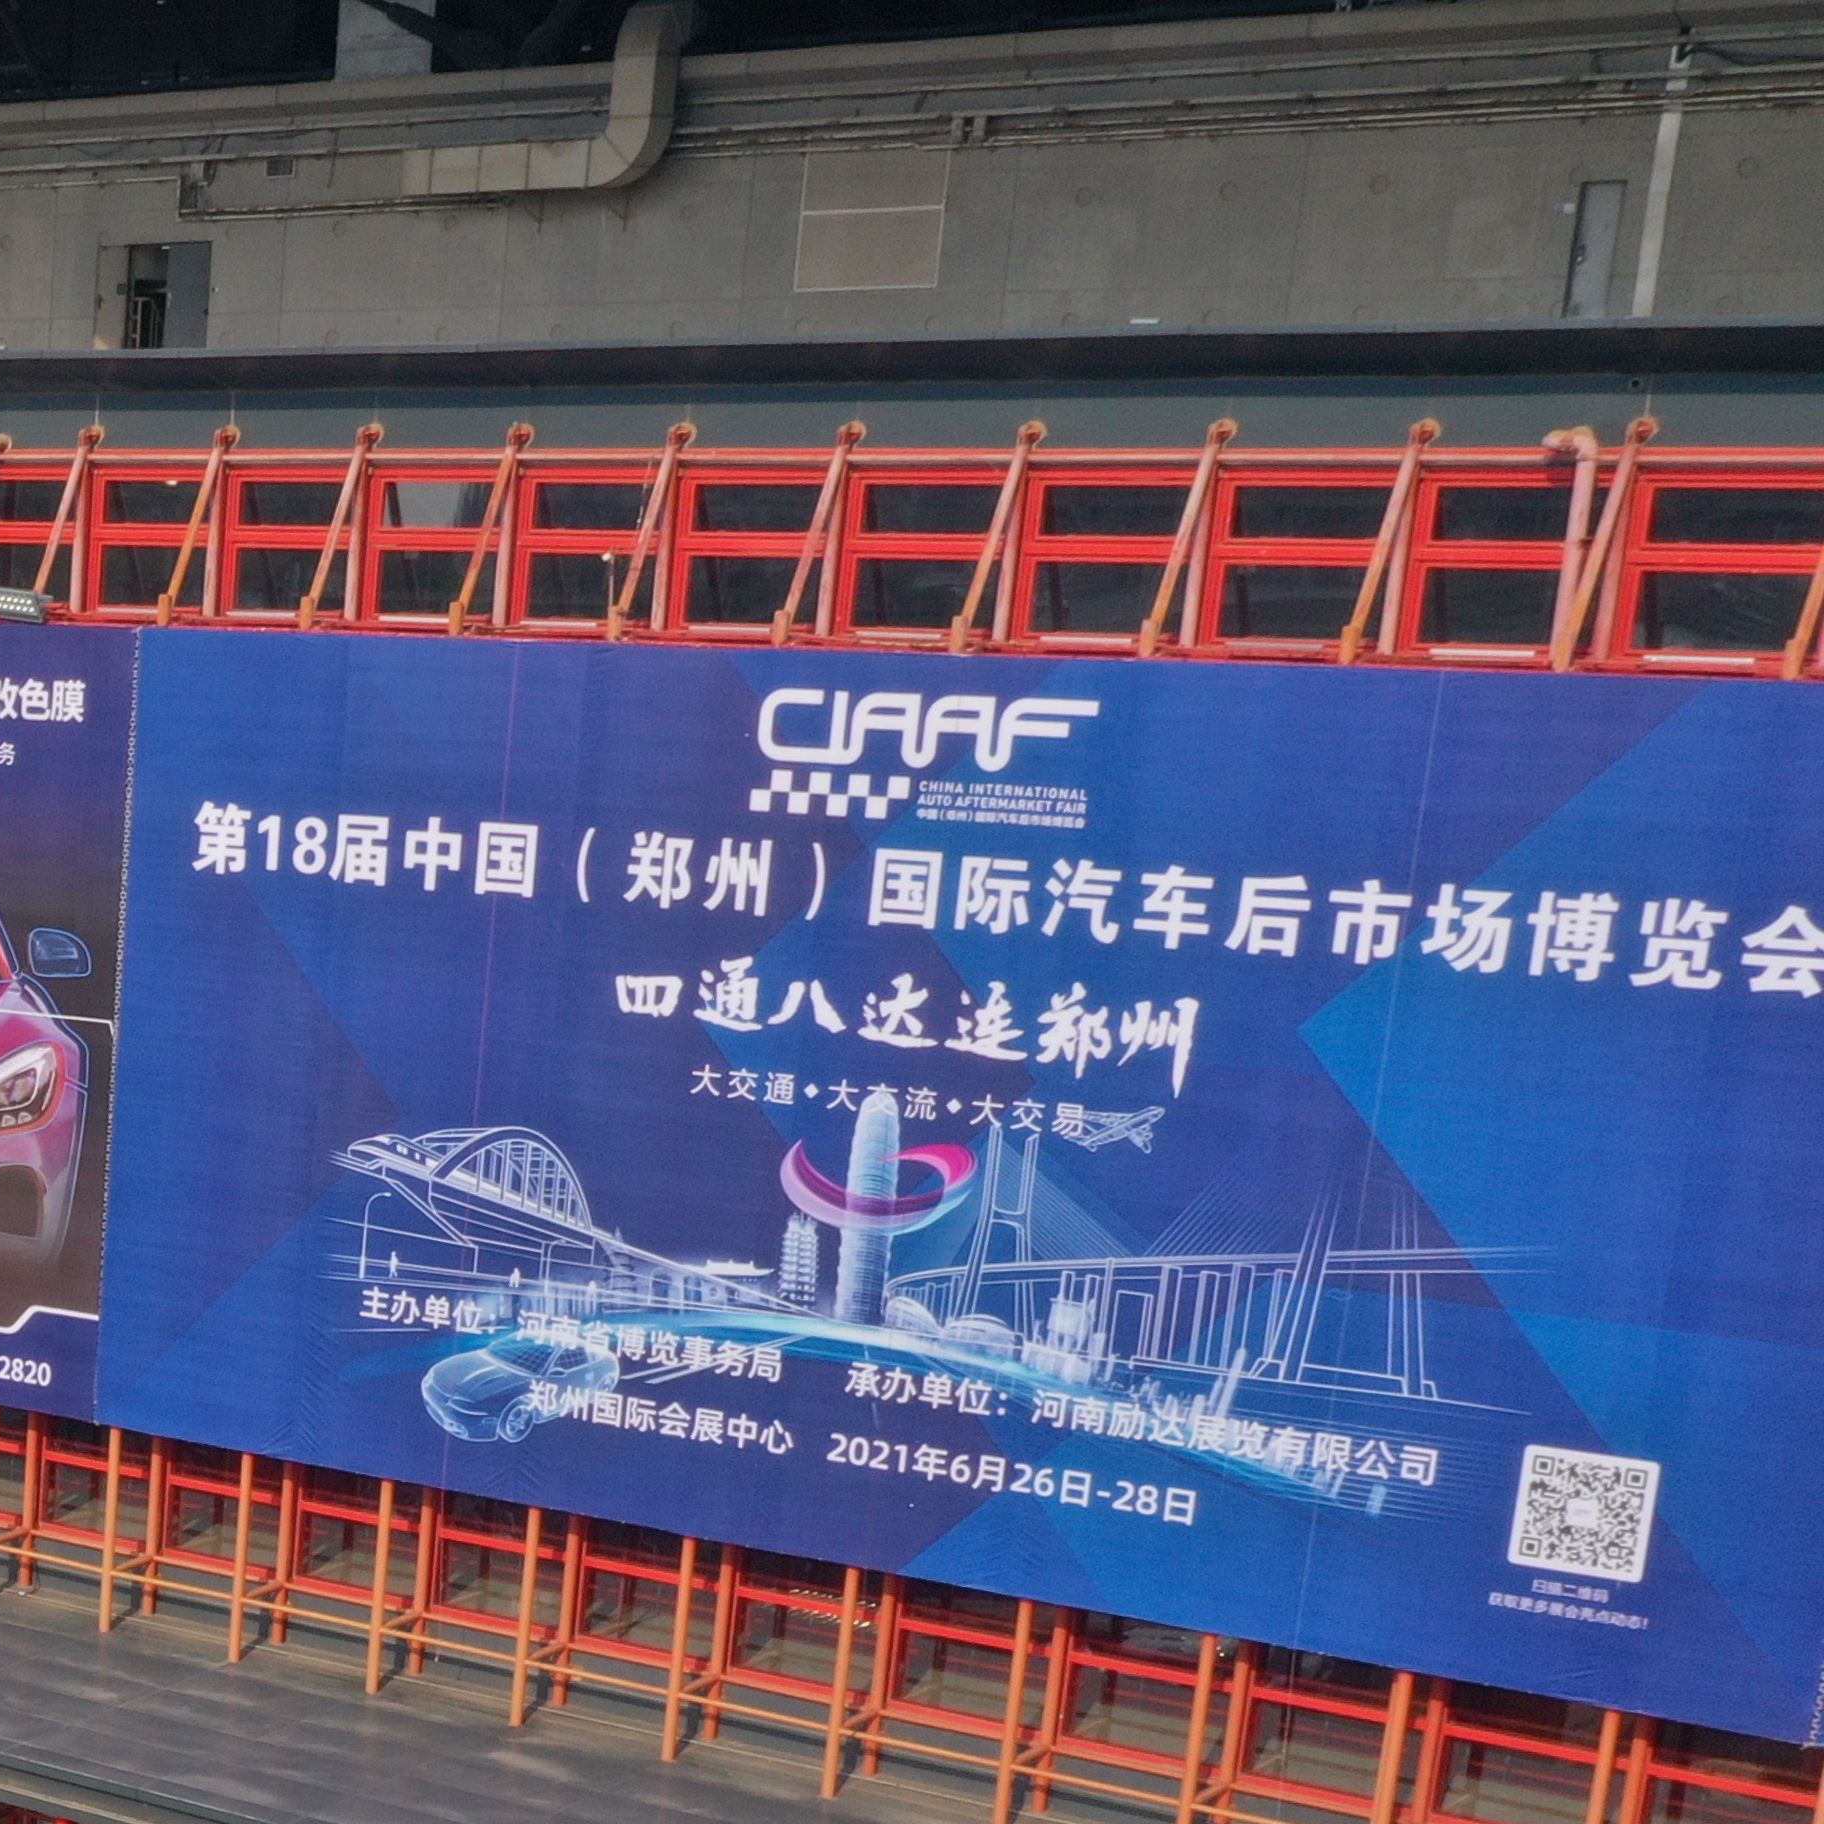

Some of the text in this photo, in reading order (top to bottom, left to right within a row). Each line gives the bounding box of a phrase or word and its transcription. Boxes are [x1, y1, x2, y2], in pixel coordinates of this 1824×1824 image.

[757, 687, 1100, 773] CIAAF
[916, 794, 1087, 815] AUTO AFTERMARKET FAIR
[918, 779, 1089, 802] CHINA INTERNATIONAL
[615, 955, 1200, 1099] 四通八达连郑州
[690, 1063, 1088, 1137] 大交通 大交流 大交易
[359, 1286, 784, 1384] 主办单位： 河南省博览事务局
[526, 1378, 794, 1456] 郑州国际会展中心
[843, 1361, 1440, 1488] 承办单位： 河南励达展览有限公司
[824, 1432, 1198, 1528] 2021年6月26日-28日
